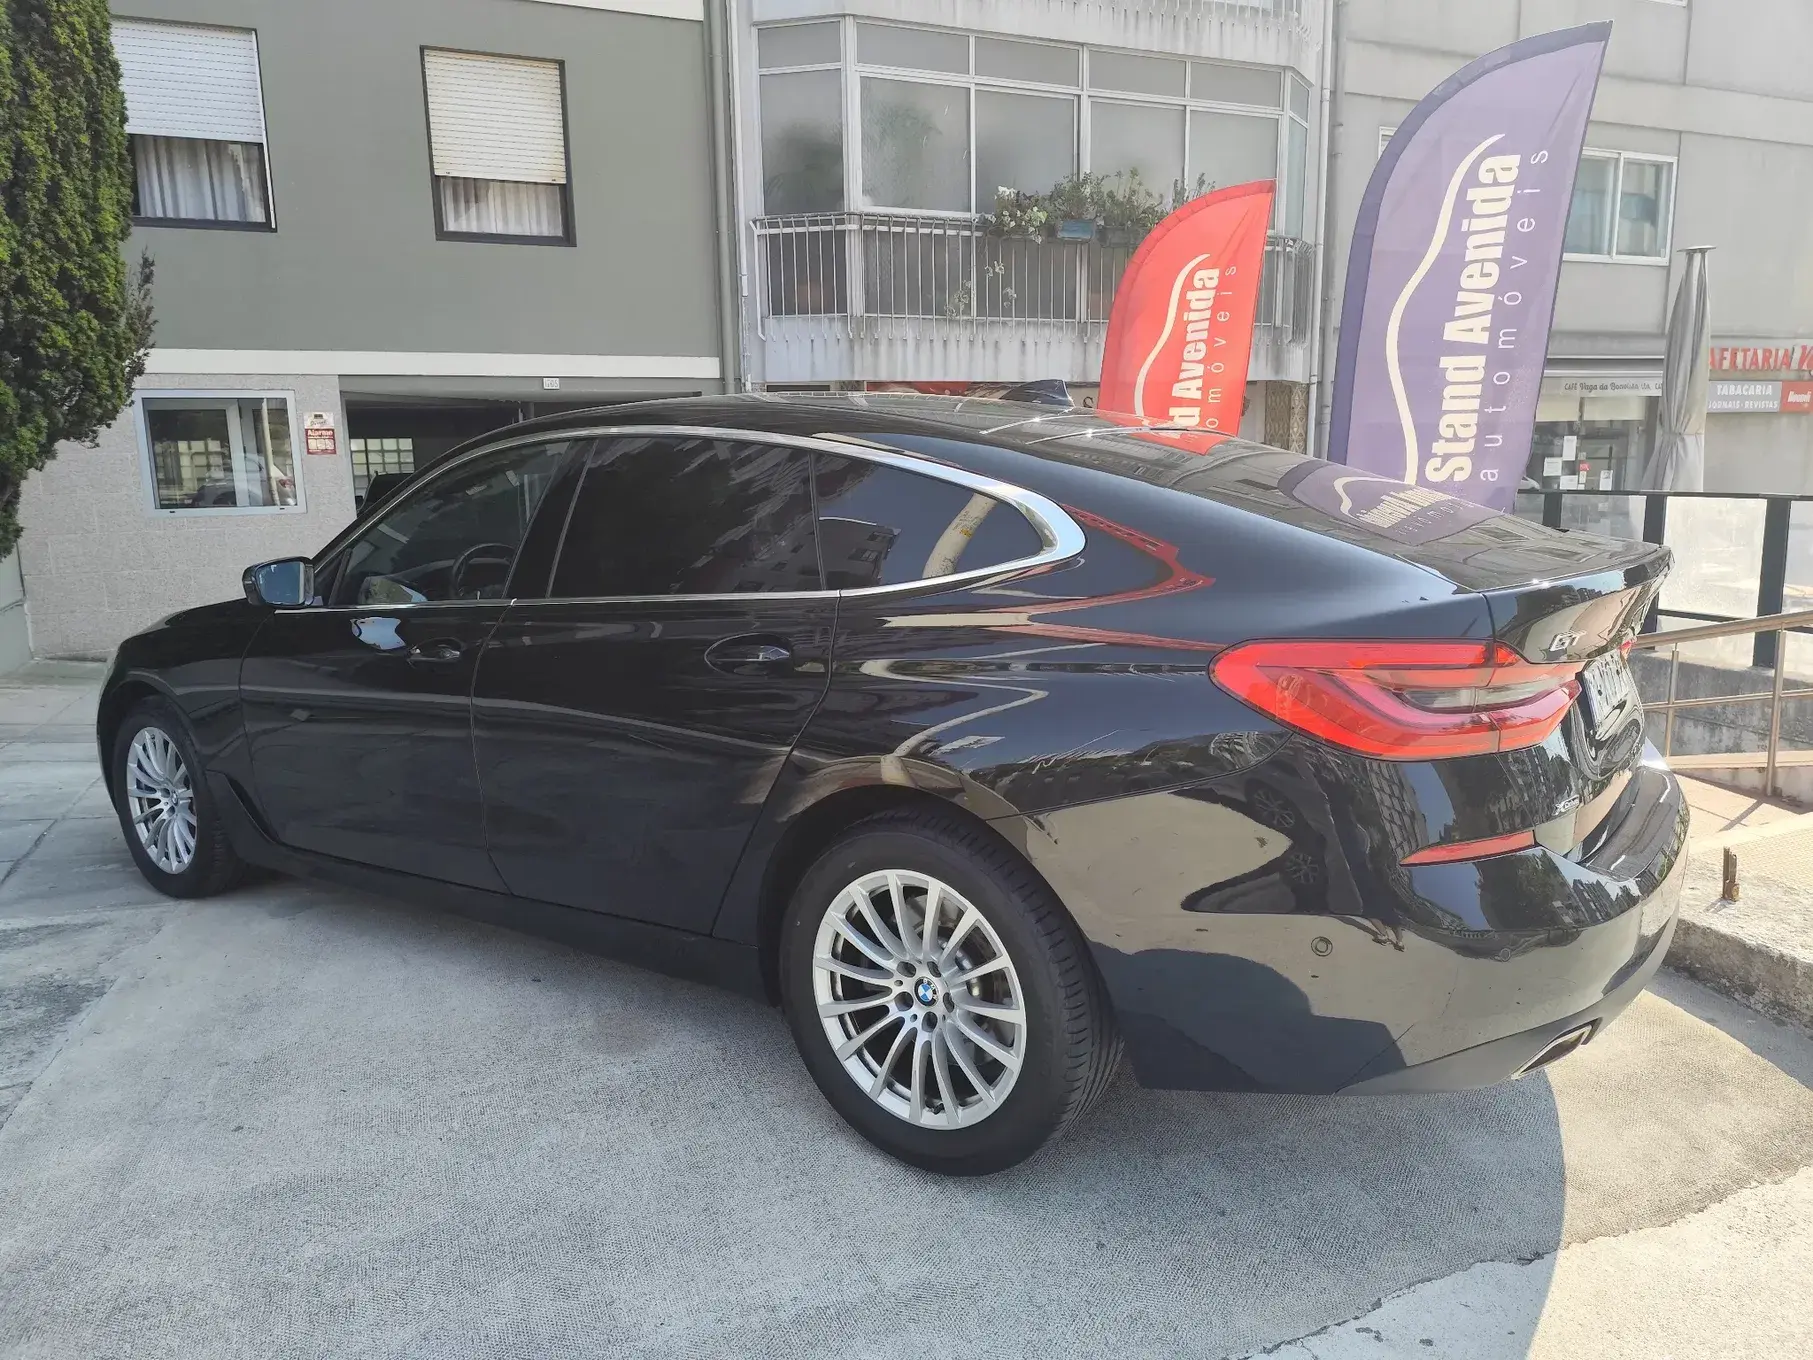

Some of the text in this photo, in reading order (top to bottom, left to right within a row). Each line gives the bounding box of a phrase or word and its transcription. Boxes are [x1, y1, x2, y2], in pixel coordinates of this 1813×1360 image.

[1171, 268, 1220, 400] Avenida
[1205, 265, 1236, 429] omóveis
[1425, 154, 1522, 482] Stand Avenida
[1480, 150, 1549, 482] automóveis
[1709, 347, 1790, 370] AFETARIA
[1708, 400, 1779, 409] JORNAIS REVISTAS
[1716, 384, 1773, 396] TABACARIA
